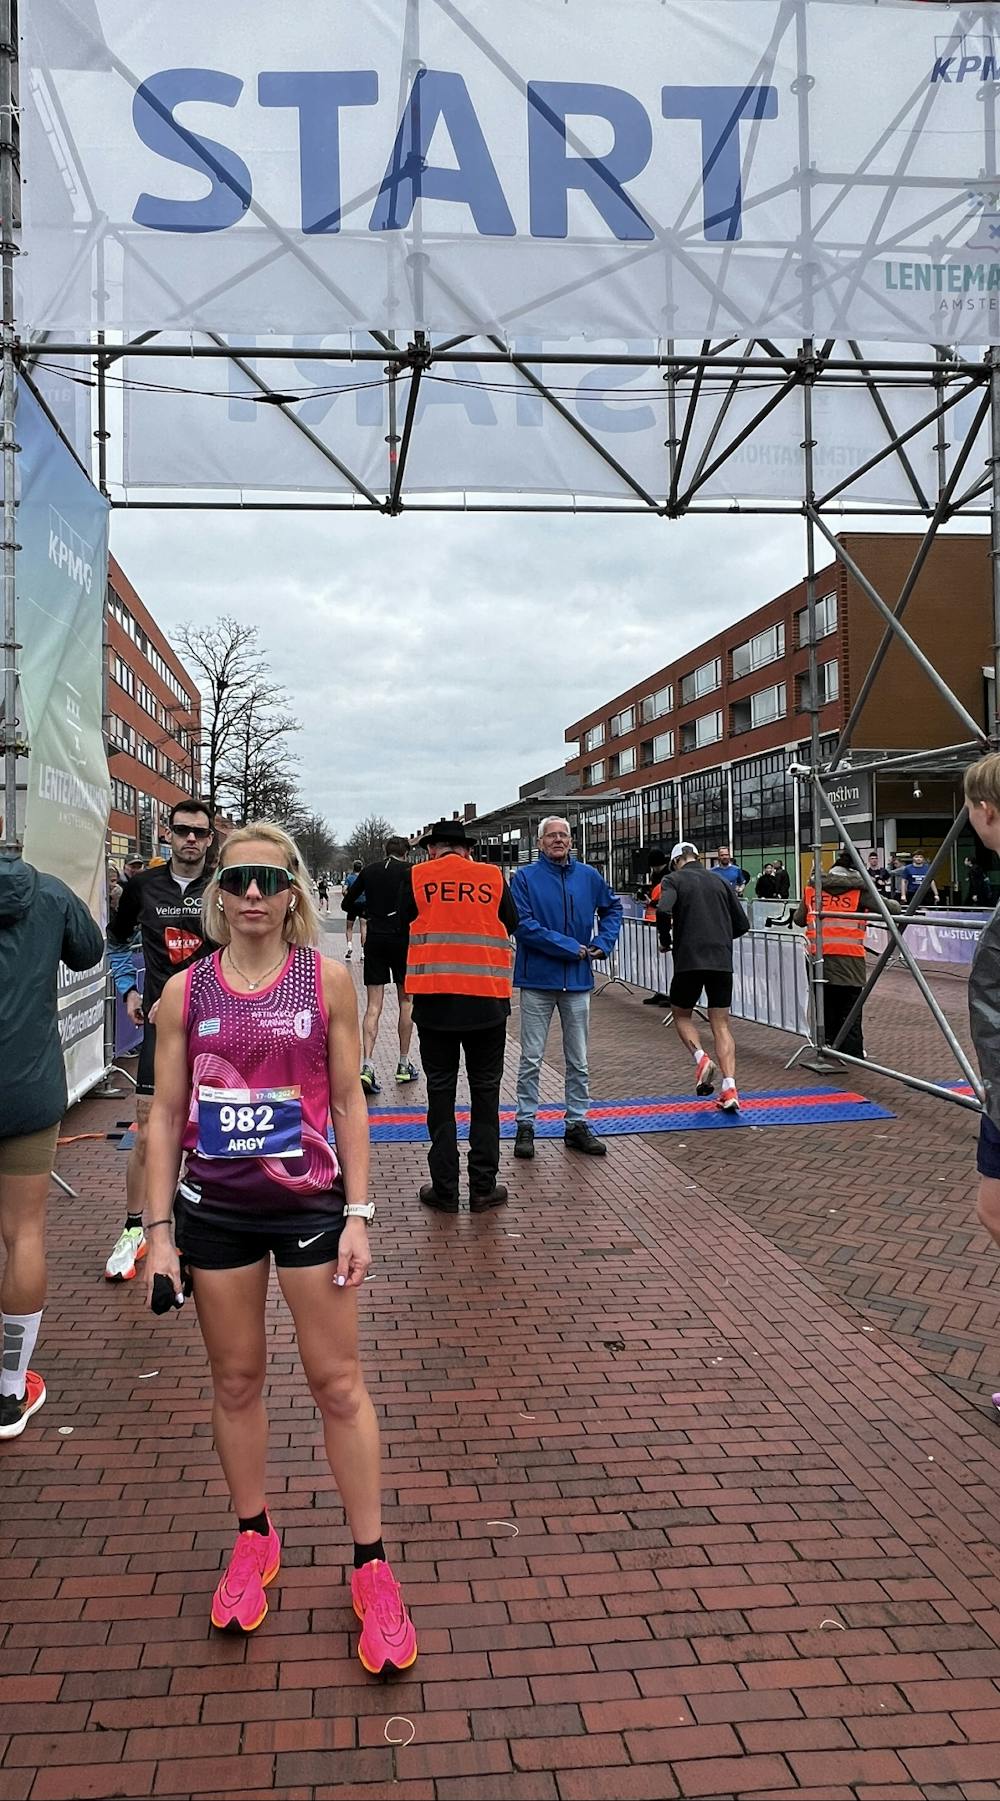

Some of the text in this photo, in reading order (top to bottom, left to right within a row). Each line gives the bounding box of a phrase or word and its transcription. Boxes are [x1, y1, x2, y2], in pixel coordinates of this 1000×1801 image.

[132, 68, 779, 241] START
[885, 262, 1000, 292] LENTEMA
[940, 298, 998, 311] AMSTE
[49, 530, 93, 595] KPMG
[826, 785, 859, 802] mstlvn
[423, 881, 492, 904] PERS
[272, 1027, 295, 1037] TEAM
[219, 1105, 274, 1132] 982
[228, 1136, 266, 1151] ARGY
